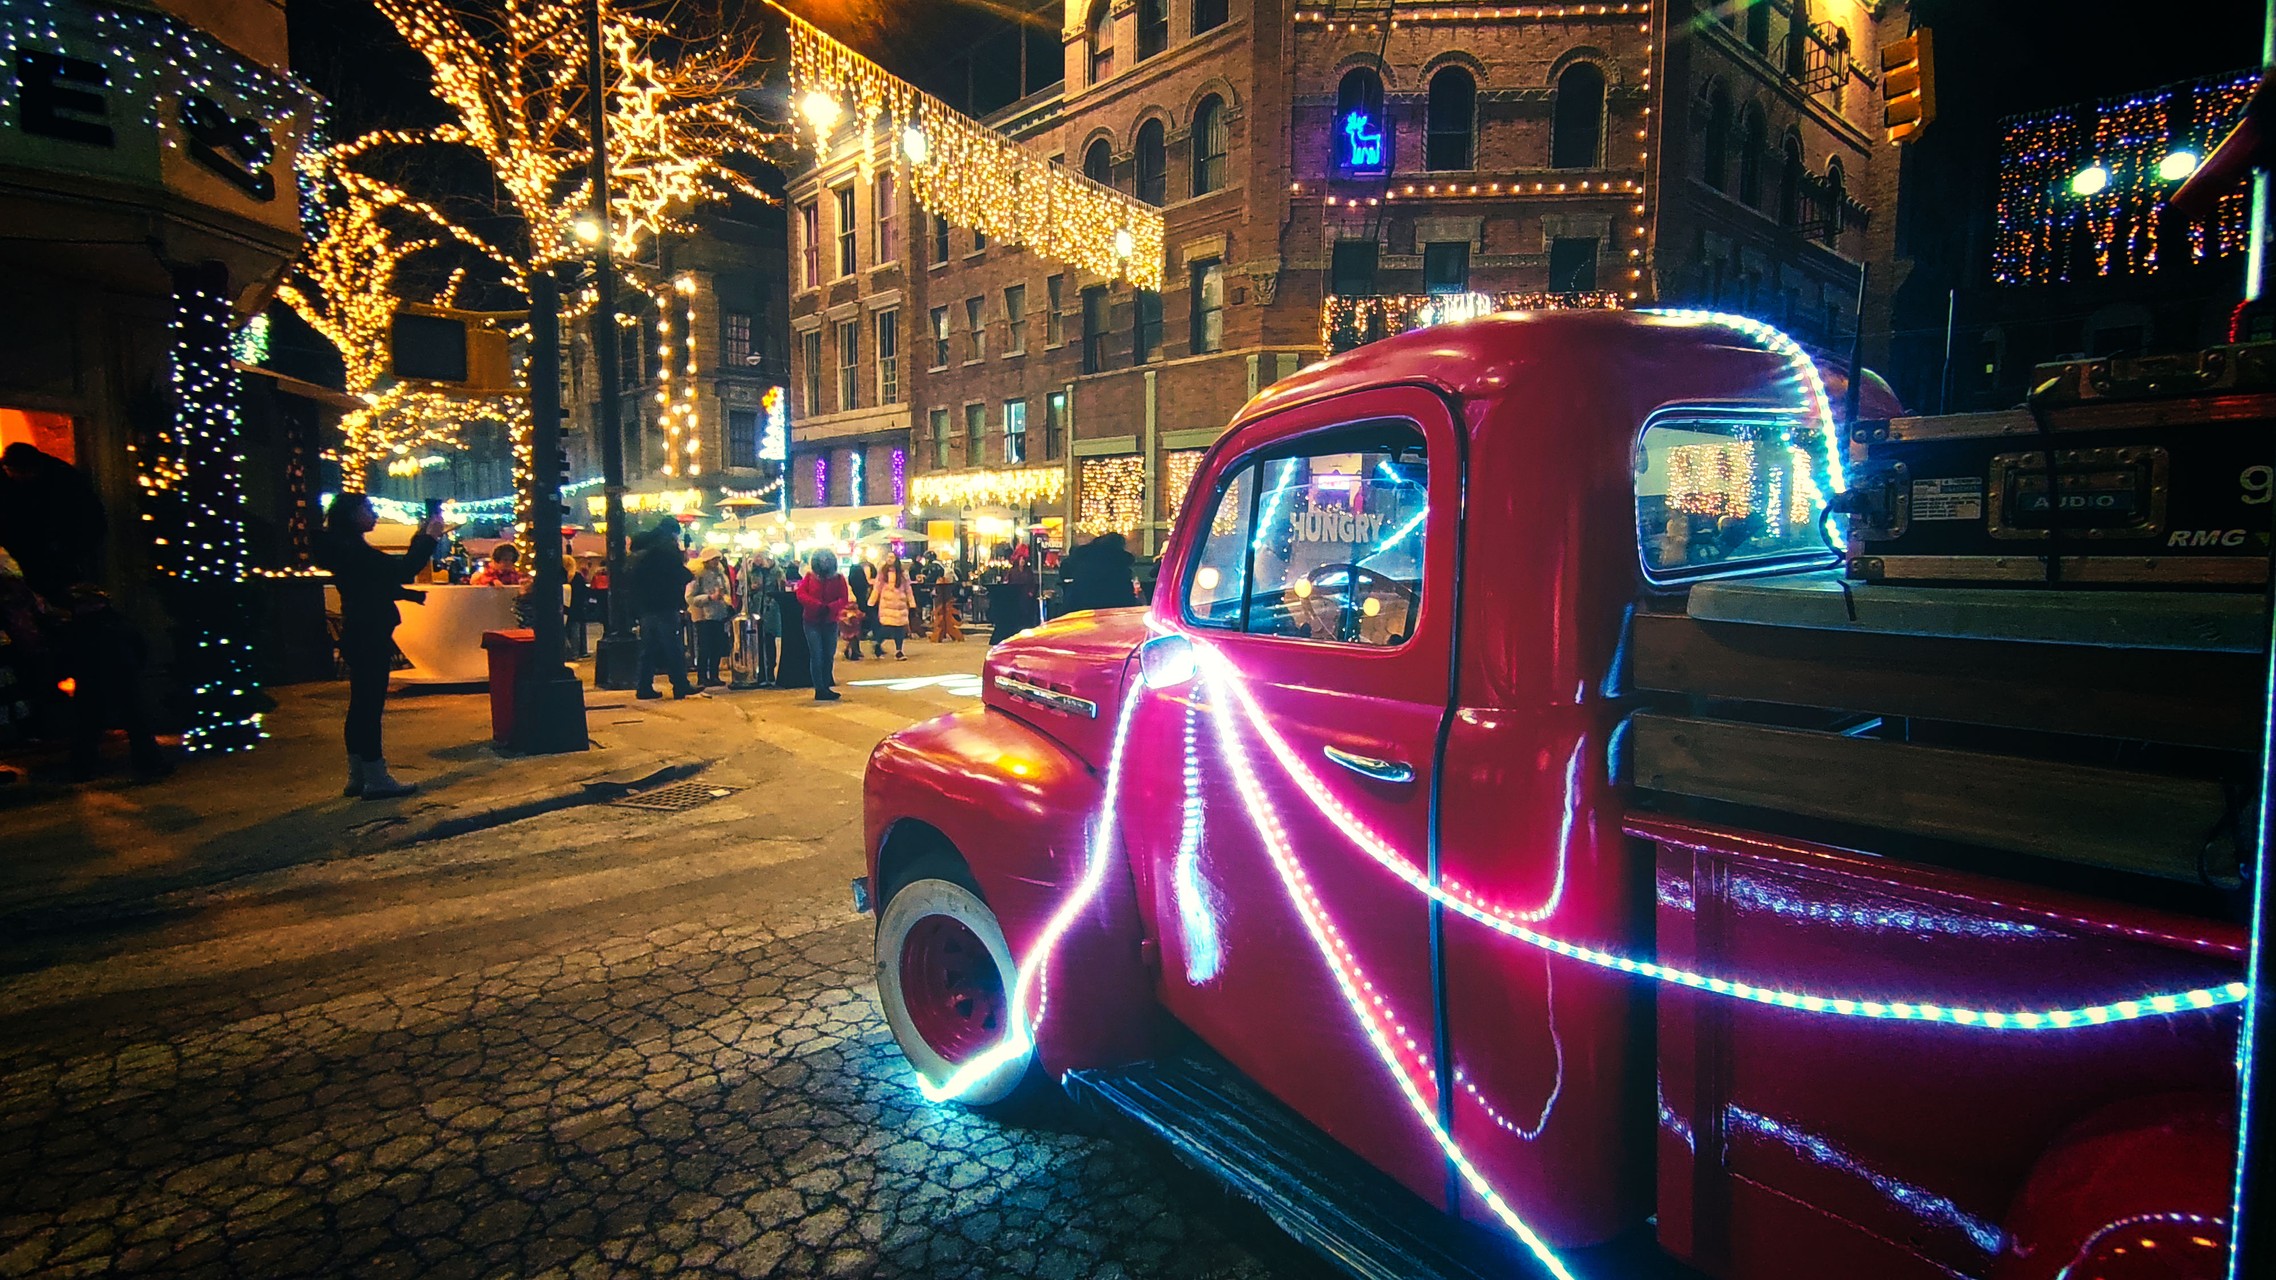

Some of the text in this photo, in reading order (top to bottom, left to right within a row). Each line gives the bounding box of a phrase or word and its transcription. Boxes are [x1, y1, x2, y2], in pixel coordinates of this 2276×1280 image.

[16, 48, 116, 148] E
[1289, 511, 1385, 543] HUNGRY
[2167, 529, 2247, 547] RMG
